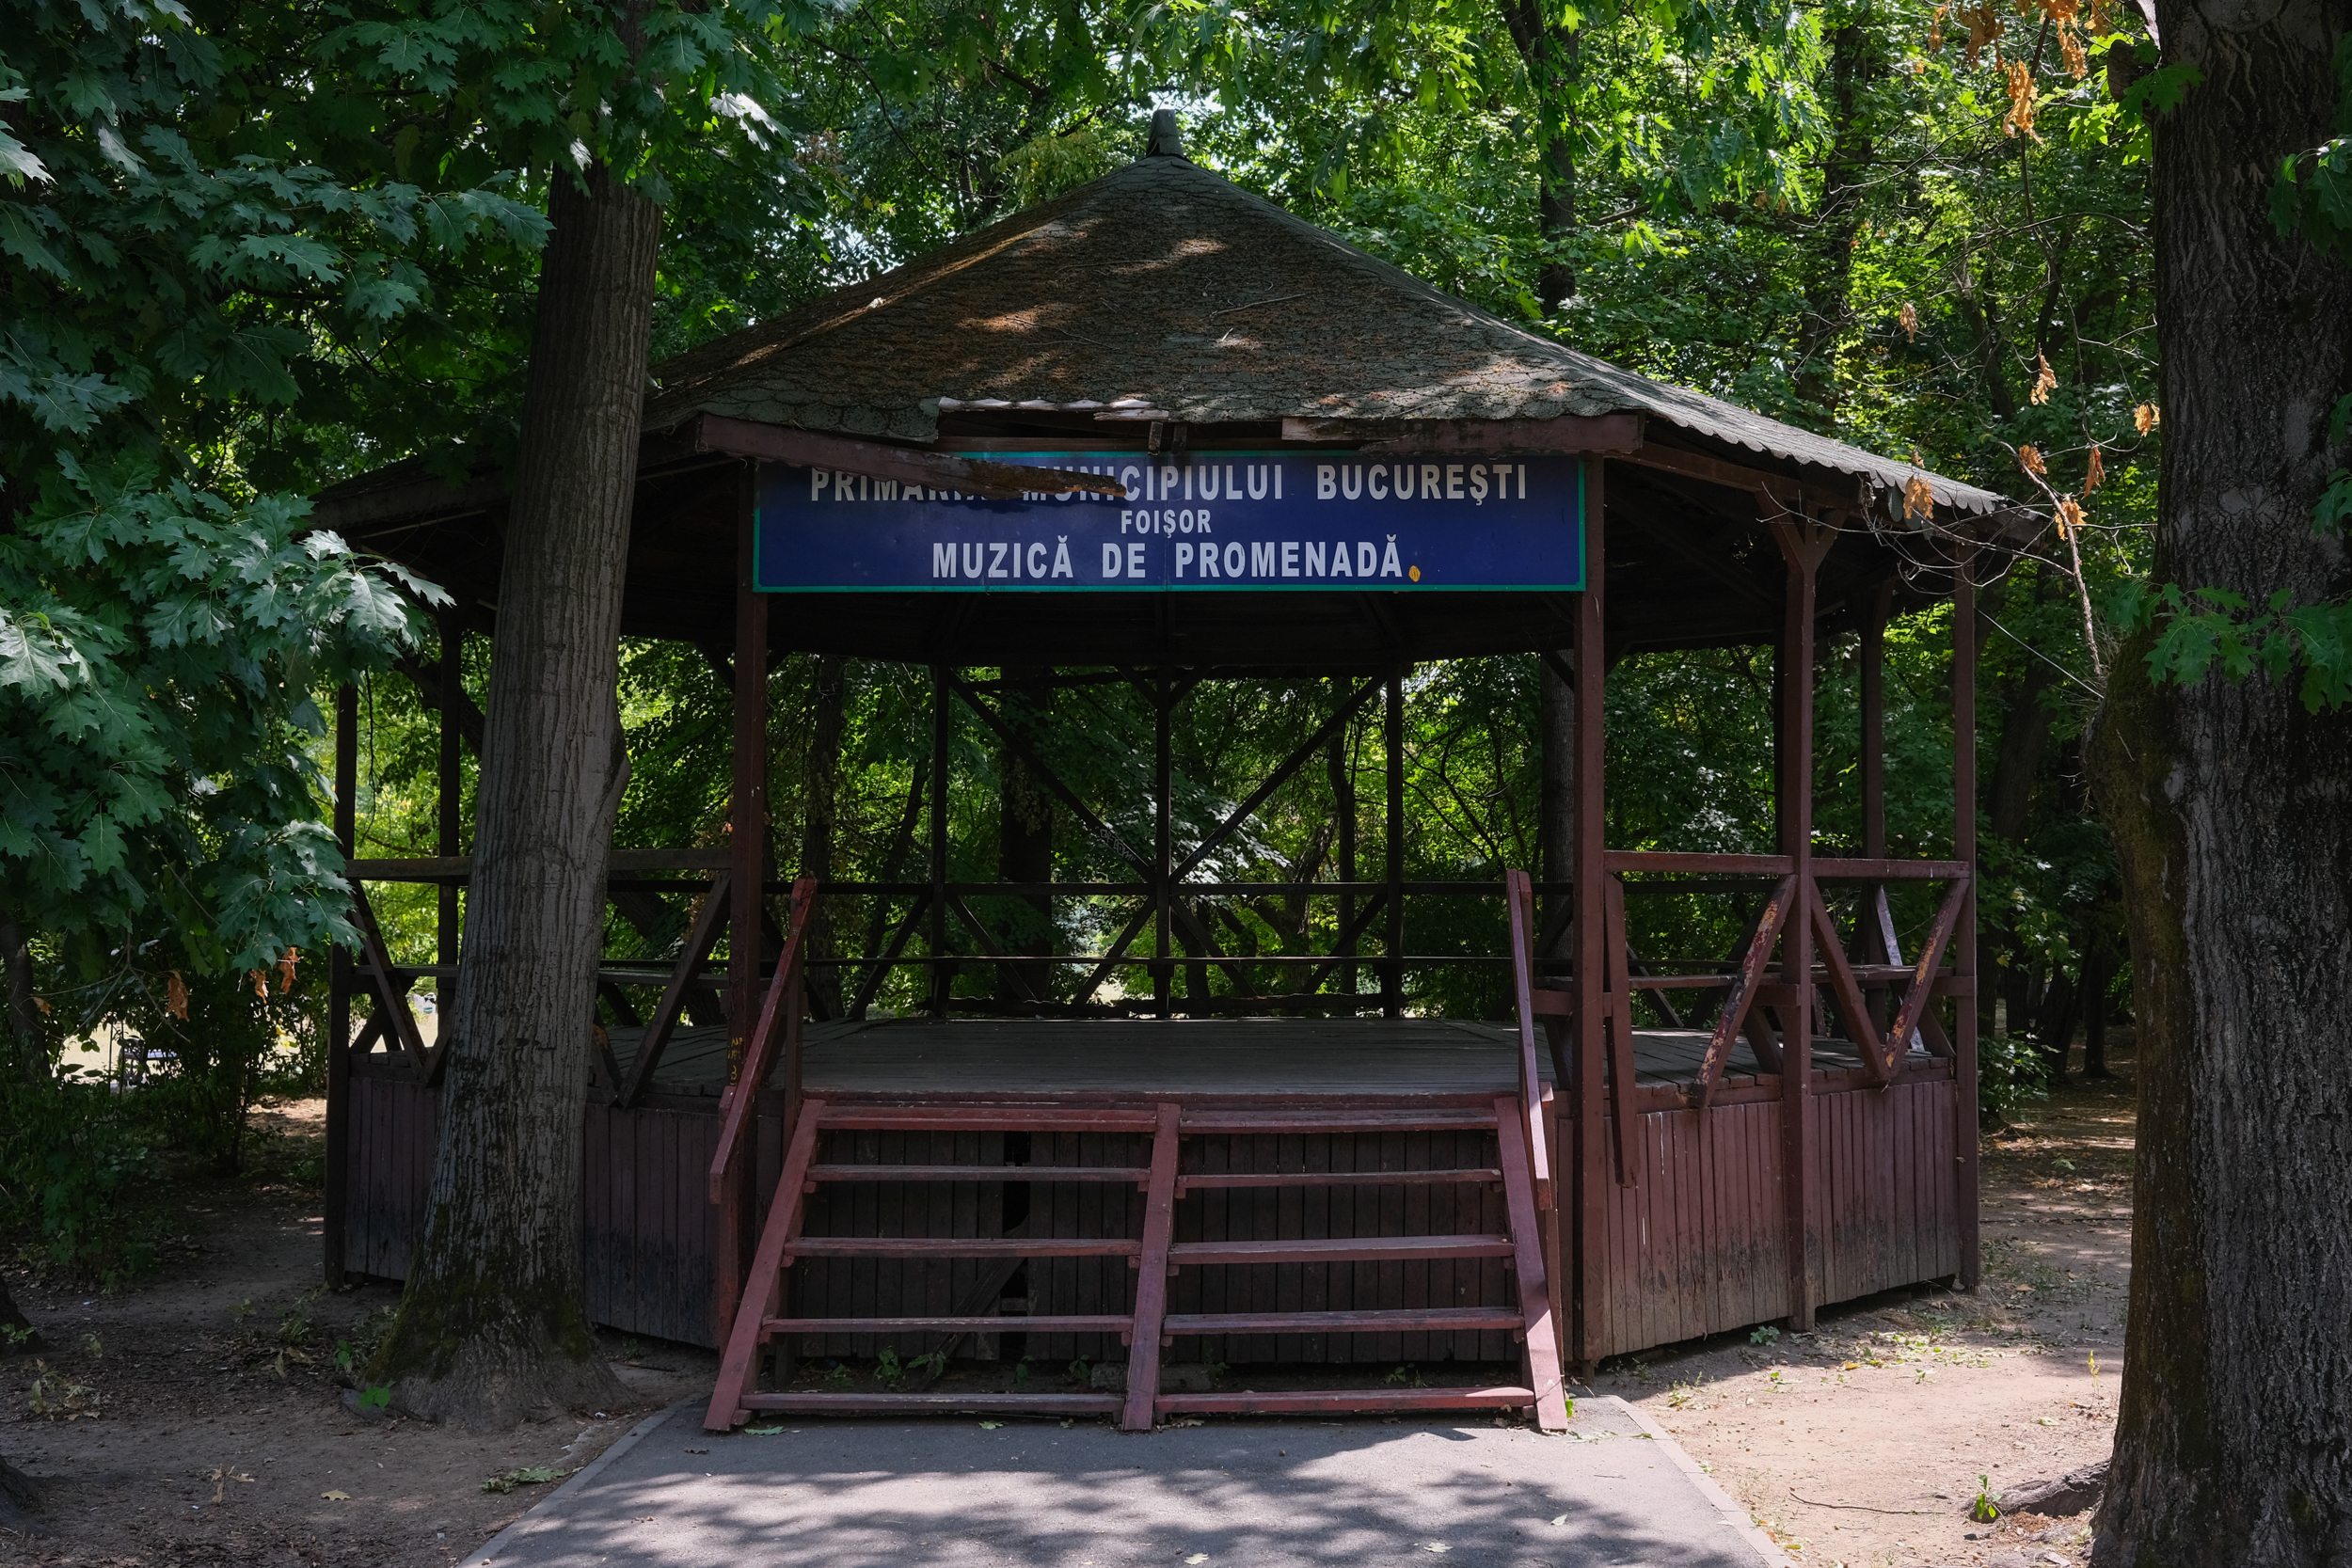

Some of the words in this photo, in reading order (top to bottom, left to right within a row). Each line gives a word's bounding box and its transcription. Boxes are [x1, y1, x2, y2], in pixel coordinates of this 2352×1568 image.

[811, 467, 988, 501] PRIM
[1317, 465, 1526, 506] BUCUREŞTI
[1120, 509, 1212, 538] FOIŞOR
[932, 534, 1074, 579] MUZICĂ
[1102, 542, 1147, 578] DE
[1175, 533, 1403, 578] PROMENADĂ
